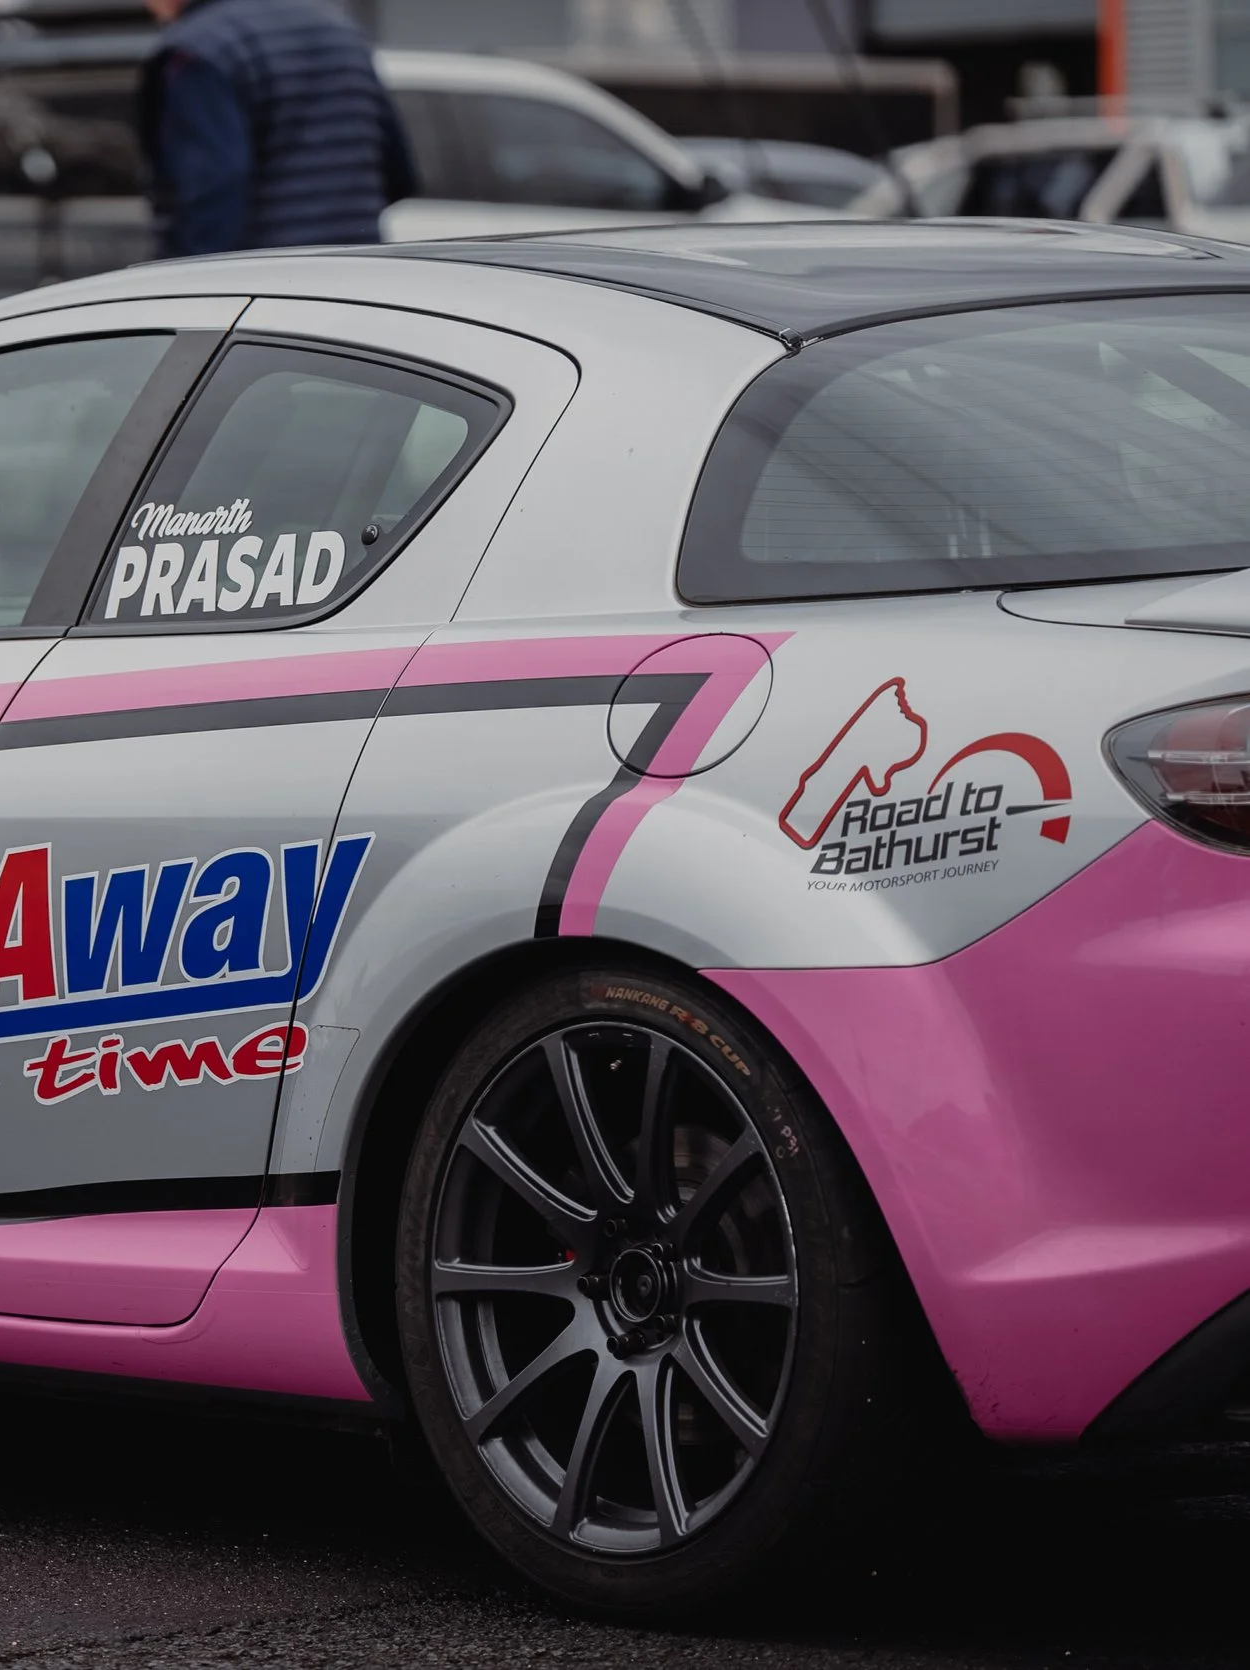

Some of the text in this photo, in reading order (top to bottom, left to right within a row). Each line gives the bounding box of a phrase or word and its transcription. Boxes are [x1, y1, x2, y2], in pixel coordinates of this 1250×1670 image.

[131, 498, 253, 541] Manarth
[104, 530, 346, 619] PRASAD
[841, 781, 1004, 838] Road to
[806, 859, 1000, 892] YOUR MOTORSPORT JOURNEY
[809, 815, 1002, 876] Bathurst
[605, 986, 670, 1012] NANKANG
[710, 1033, 751, 1076] CUP
[25, 1020, 310, 1106] time
